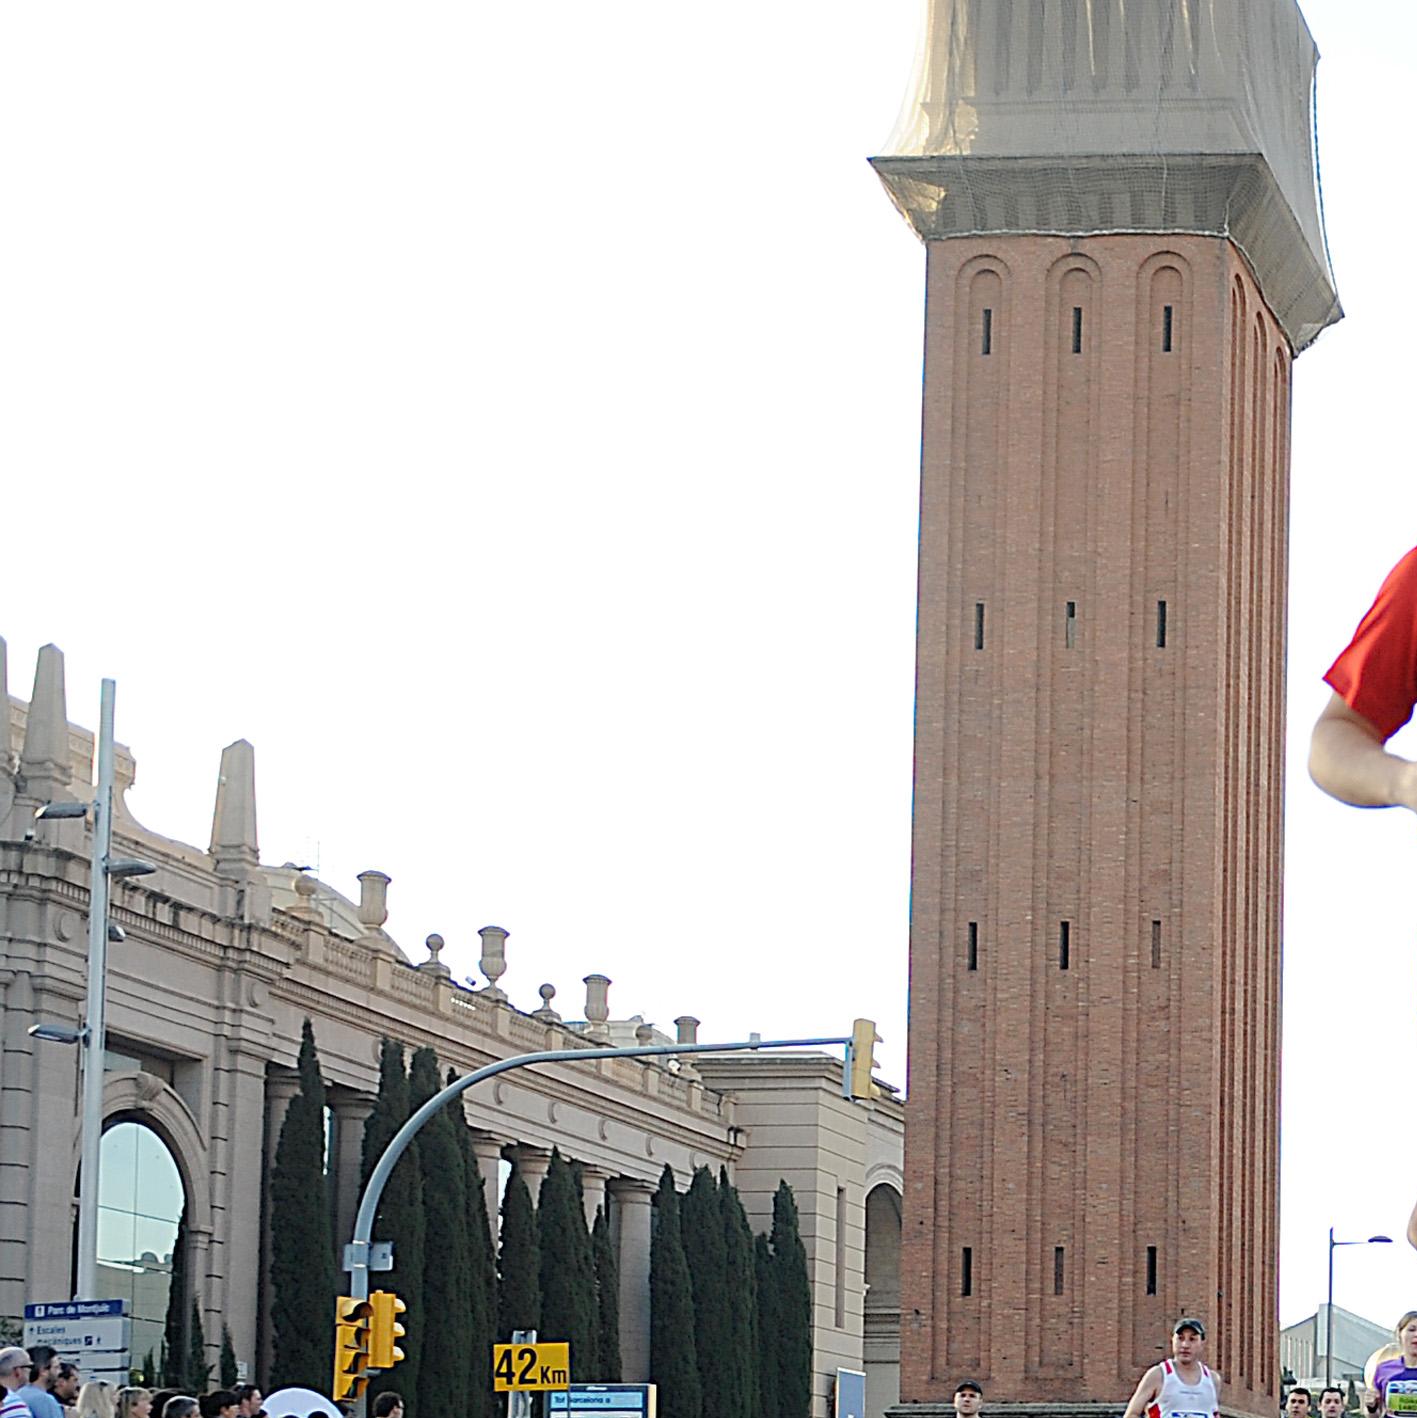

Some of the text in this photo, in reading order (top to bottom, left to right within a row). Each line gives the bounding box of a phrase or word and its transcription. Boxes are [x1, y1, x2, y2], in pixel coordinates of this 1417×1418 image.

[37, 1326, 66, 1335] Escales
[495, 1347, 567, 1386] 42 Km
